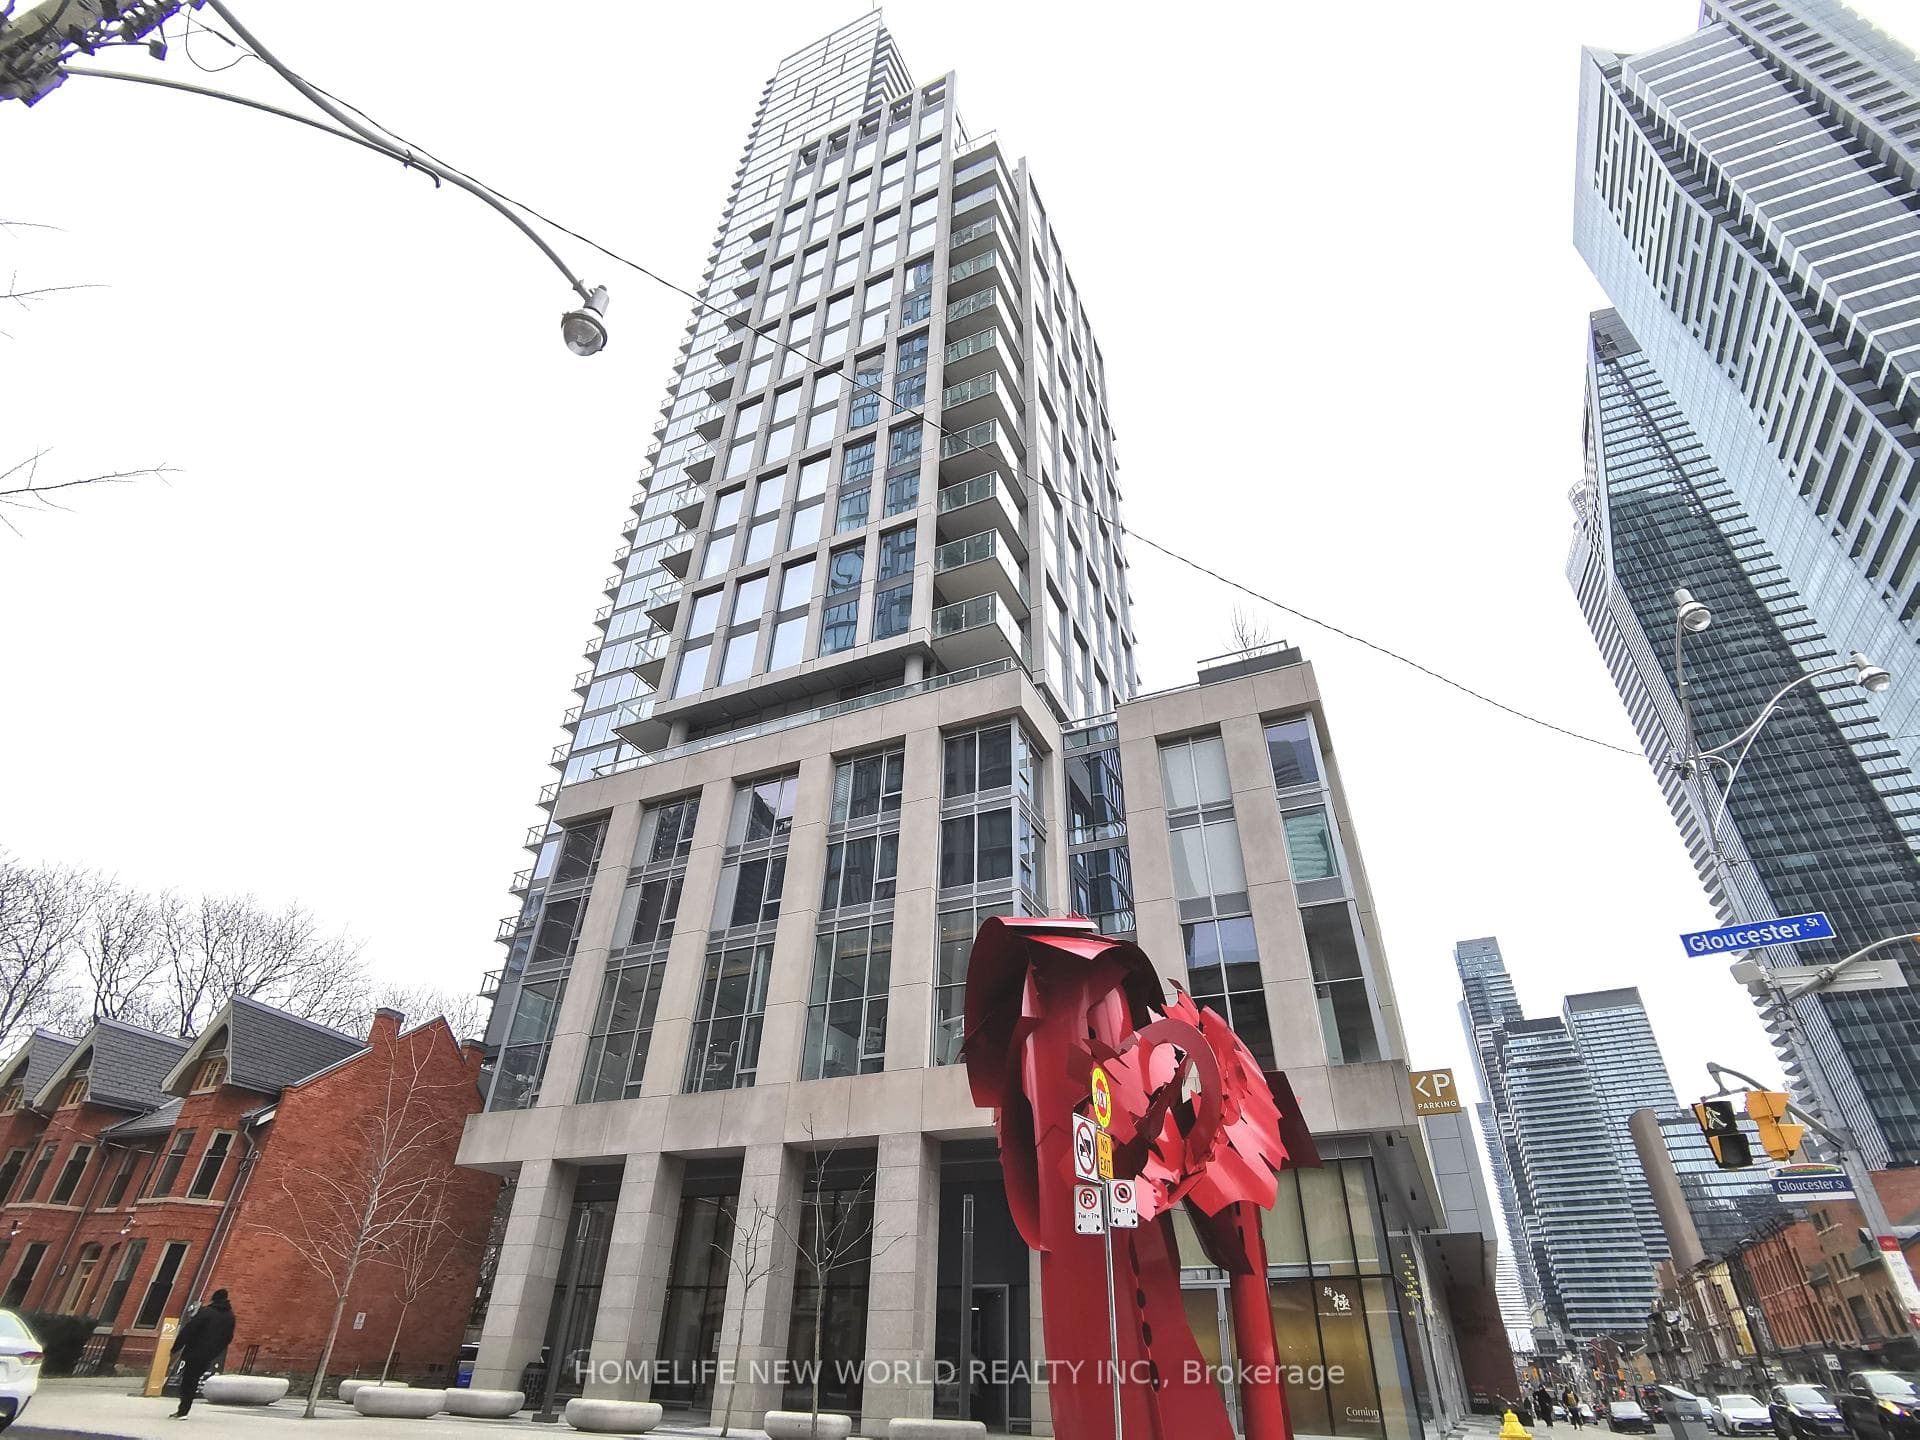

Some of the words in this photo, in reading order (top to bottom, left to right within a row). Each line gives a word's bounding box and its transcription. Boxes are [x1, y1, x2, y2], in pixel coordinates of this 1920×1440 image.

[1689, 923, 1801, 952] Gloucester
[1806, 917, 1820, 928] St
[1432, 1073, 1450, 1097] P
[1417, 1100, 1457, 1110] PARKING
[1101, 1137, 1109, 1154] NO
[1100, 1156, 1111, 1175] EXIT
[1777, 1180, 1834, 1192] Gloucester
[1835, 1181, 1846, 1189] St
[1828, 1360, 1840, 1369] 40
[1345, 1406, 1380, 1419] Coming
